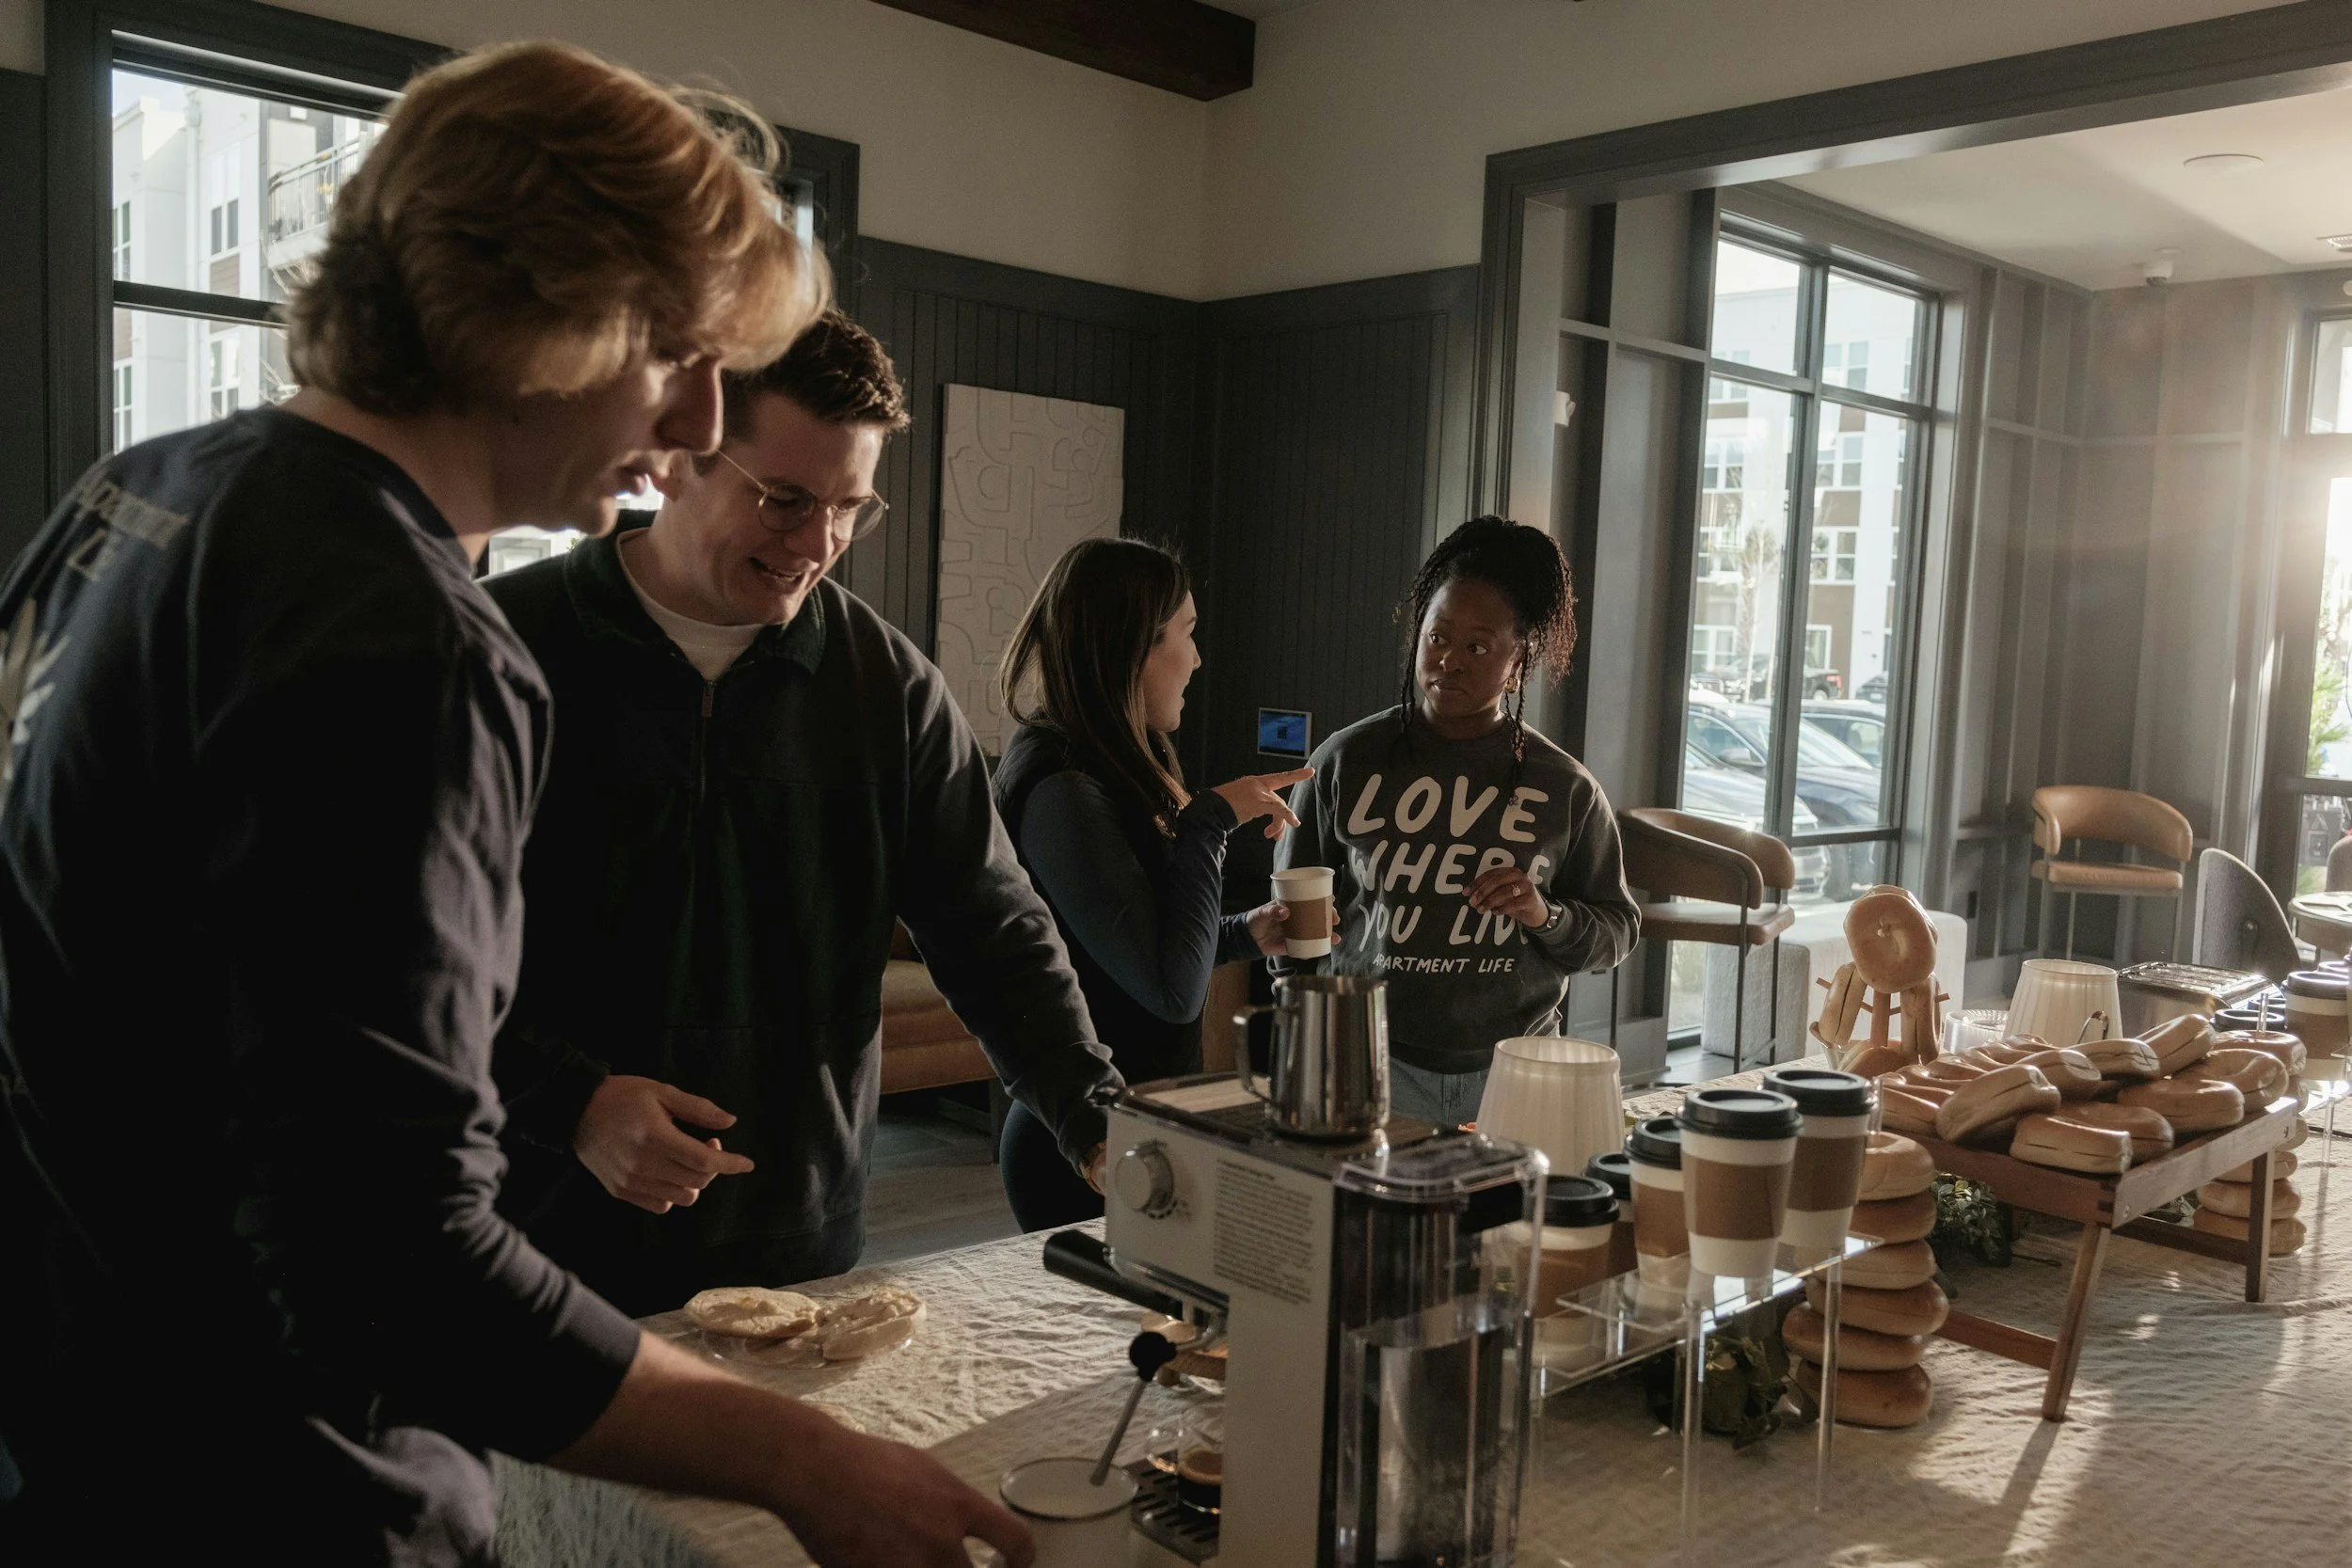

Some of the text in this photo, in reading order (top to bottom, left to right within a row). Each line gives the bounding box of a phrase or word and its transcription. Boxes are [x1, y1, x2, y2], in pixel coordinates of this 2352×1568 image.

[1347, 773, 1549, 843] LOVE
[1358, 900, 1528, 953] YOU LIV
[1373, 953, 1516, 974] APARTMENT LIFE
